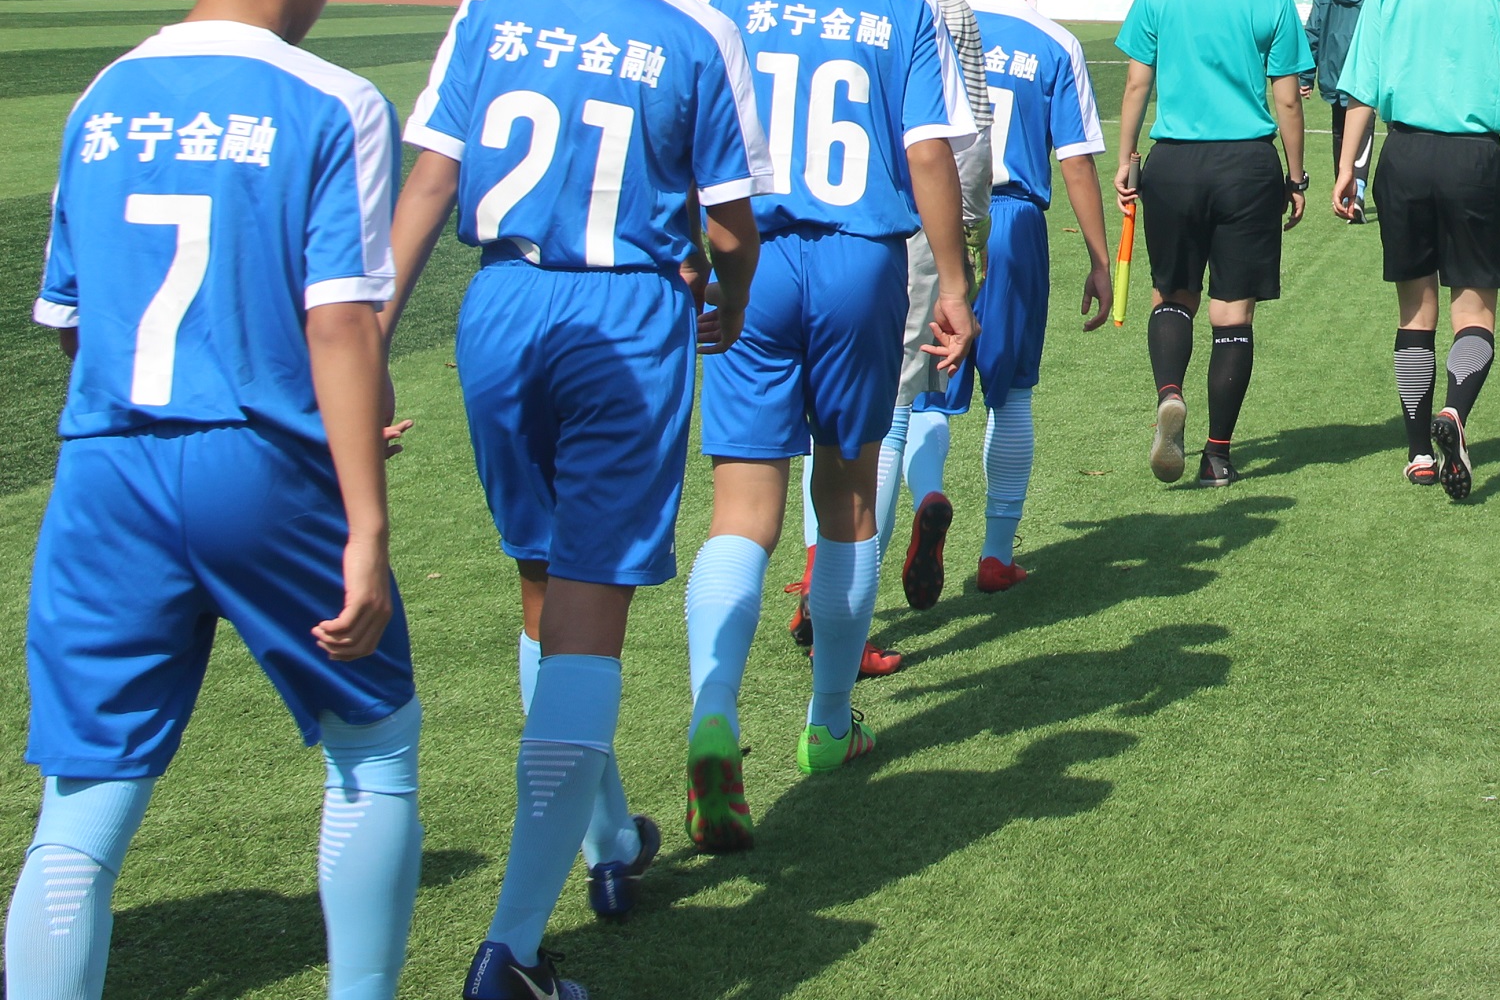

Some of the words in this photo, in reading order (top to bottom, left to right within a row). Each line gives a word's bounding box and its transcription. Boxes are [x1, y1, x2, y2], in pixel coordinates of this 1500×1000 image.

[488, 21, 666, 88] 苏宁金融
[746, 0, 892, 50] 苏宁金融
[80, 112, 278, 167] 苏宁金融
[476, 90, 635, 268] 21
[756, 51, 871, 207] 16
[125, 193, 213, 406] 7
